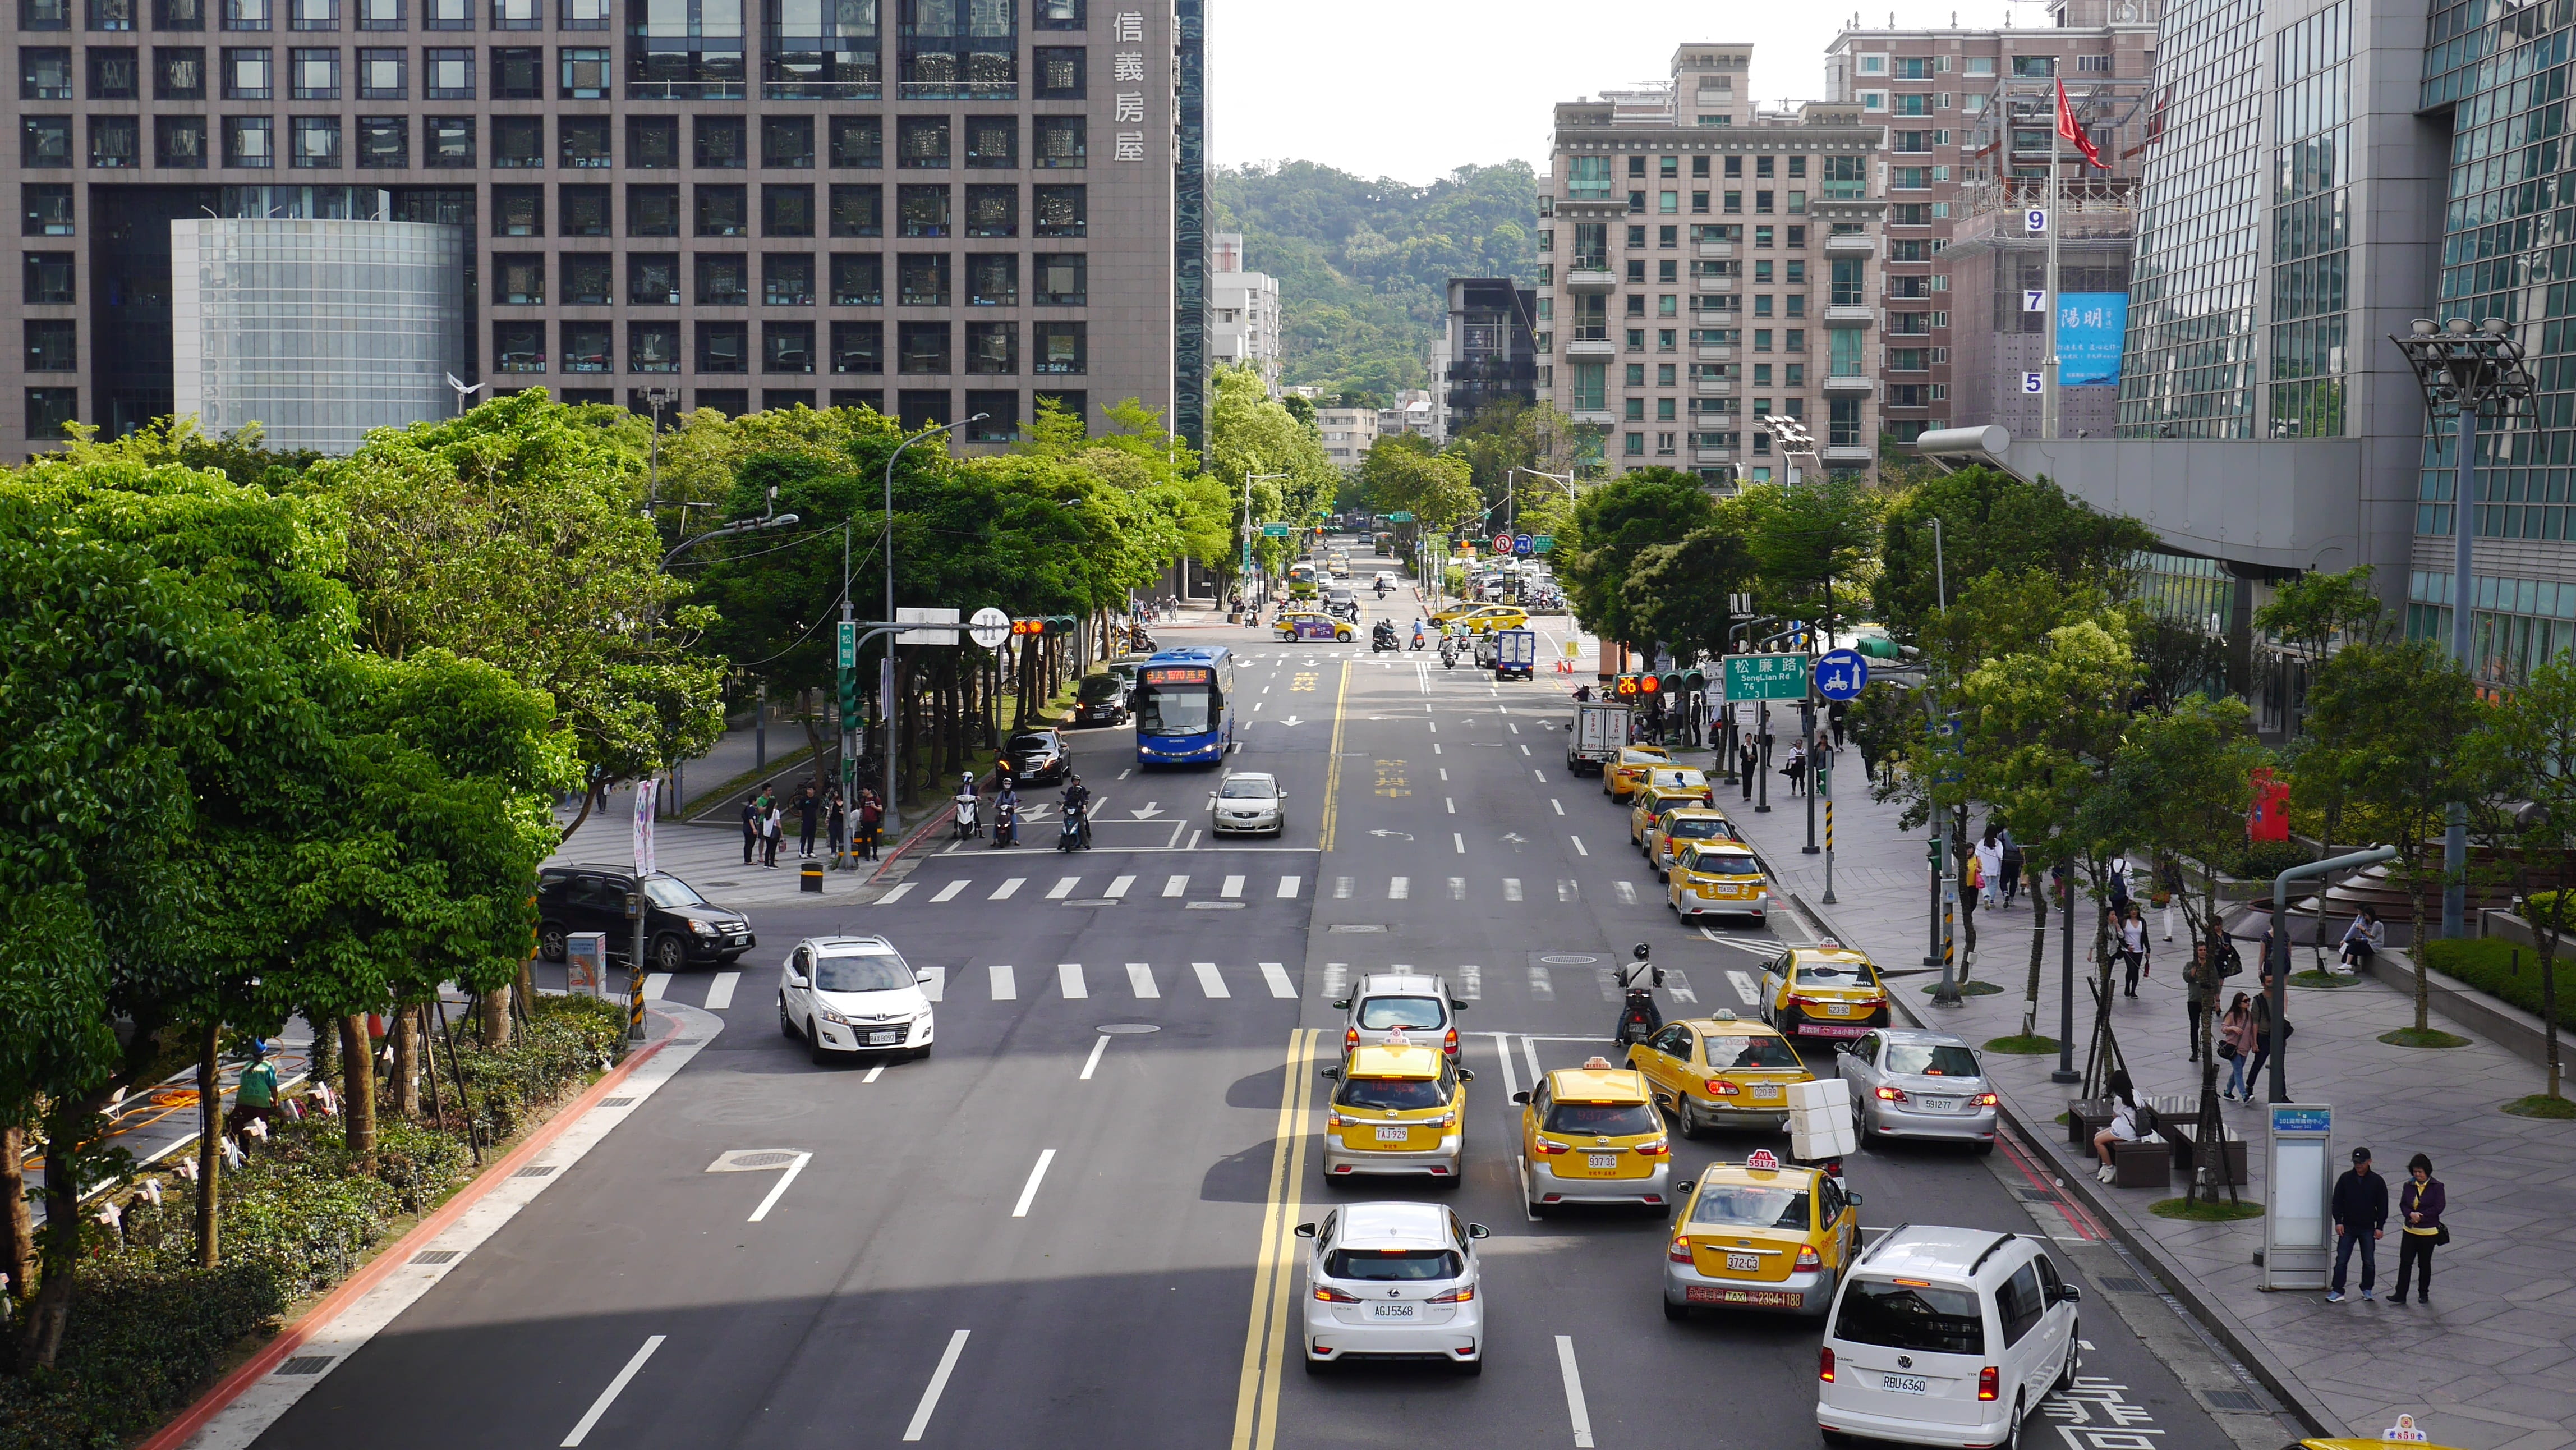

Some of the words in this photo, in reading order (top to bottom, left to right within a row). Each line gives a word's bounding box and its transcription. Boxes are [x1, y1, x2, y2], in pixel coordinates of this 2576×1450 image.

[1113, 11, 1144, 162] 信義房屋
[2028, 211, 2044, 230] 9
[2027, 292, 2043, 310] 7
[2062, 307, 2102, 328] 陽明
[2026, 374, 2041, 392] 5
[1013, 621, 1026, 632] 26
[1735, 658, 1796, 674] 松廉路
[1619, 677, 1636, 694] 26
[1749, 1159, 1777, 1168] 55178
[1727, 1292, 1747, 1302] TAXI
[1758, 1292, 1801, 1307] 2394-1188
[2397, 1431, 2415, 1440] 859
